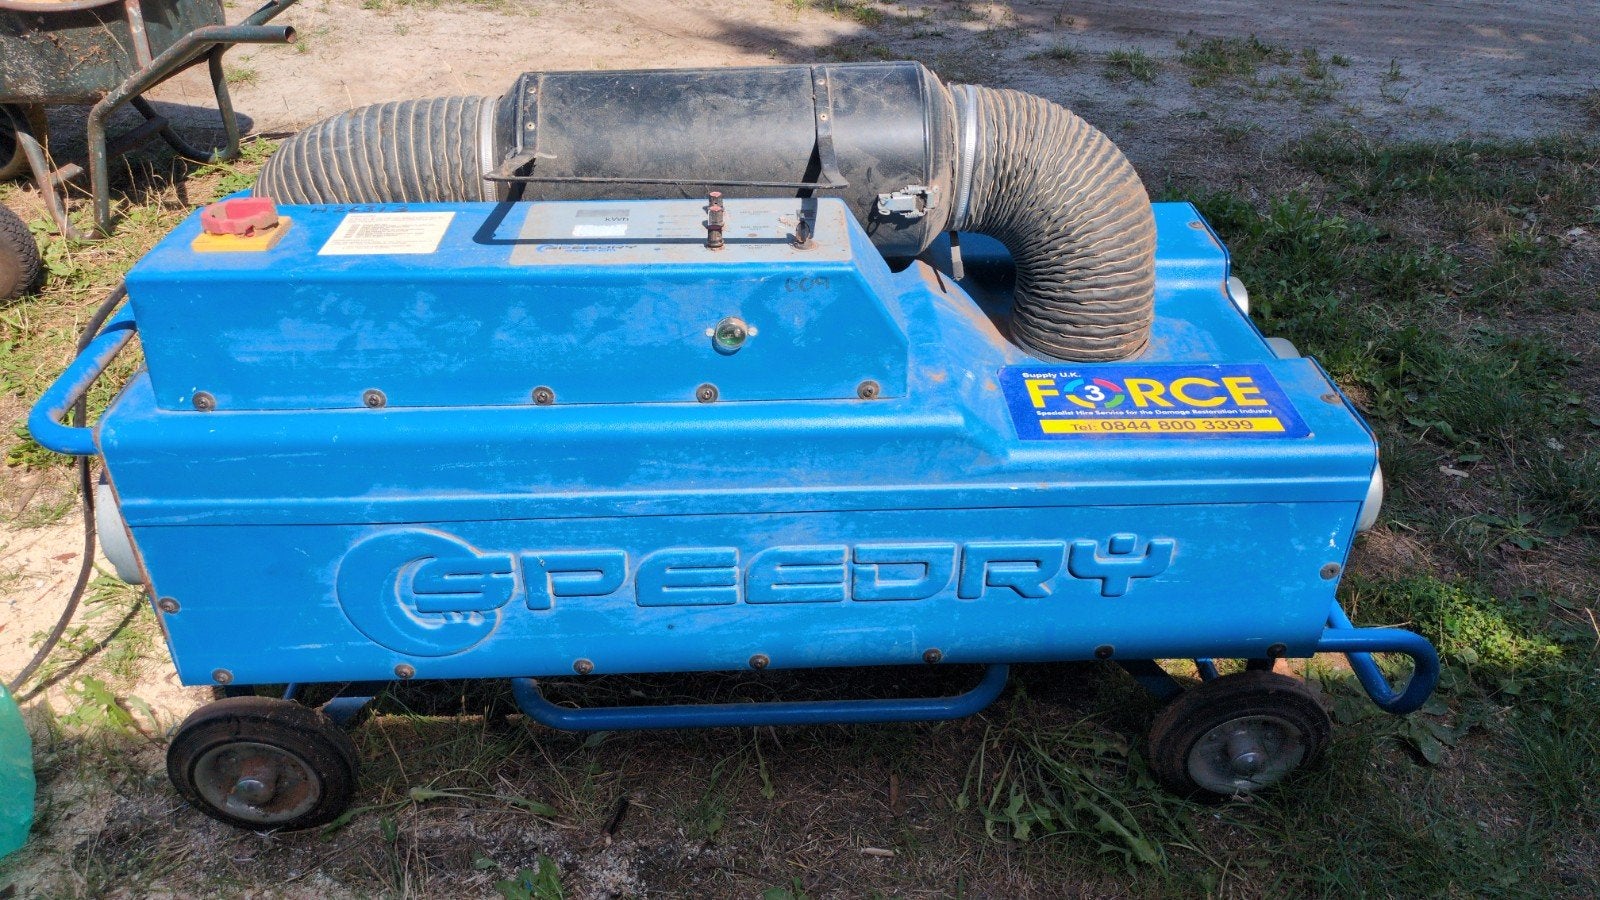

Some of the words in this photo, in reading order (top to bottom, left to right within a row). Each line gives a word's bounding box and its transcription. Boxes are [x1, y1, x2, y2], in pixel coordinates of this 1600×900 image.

[1024, 376, 1269, 409] FORCE
[1084, 384, 1106, 402] 3
[1071, 423, 1098, 431] Tel:
[1100, 421, 1152, 431] 0844
[1158, 420, 1196, 431] 800
[1202, 420, 1254, 430] 3399
[335, 528, 1176, 657] SPEEDRY
